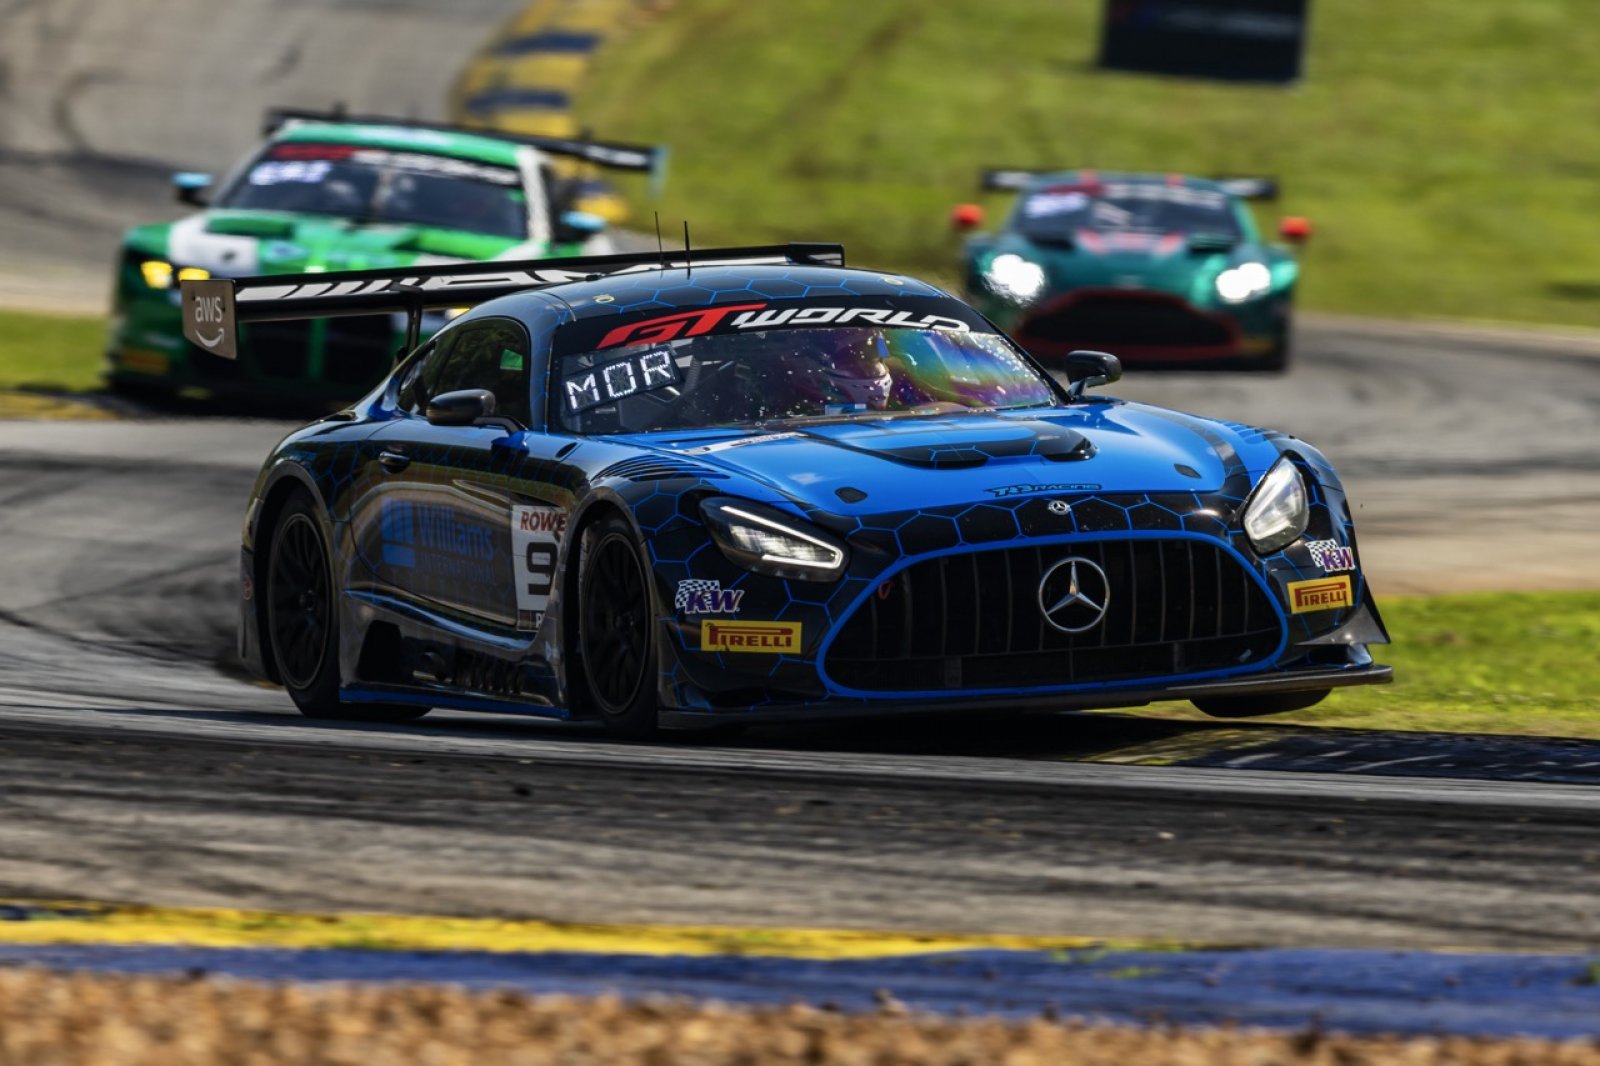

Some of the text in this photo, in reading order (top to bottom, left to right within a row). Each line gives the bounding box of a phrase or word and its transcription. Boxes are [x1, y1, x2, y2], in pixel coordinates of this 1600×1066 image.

[194, 296, 223, 323] aws
[565, 351, 676, 410] MOR
[417, 502, 495, 561] Williams
[520, 510, 569, 532] ROWE
[1294, 582, 1348, 607] PIRELLI
[708, 625, 794, 648] PIRELLI
